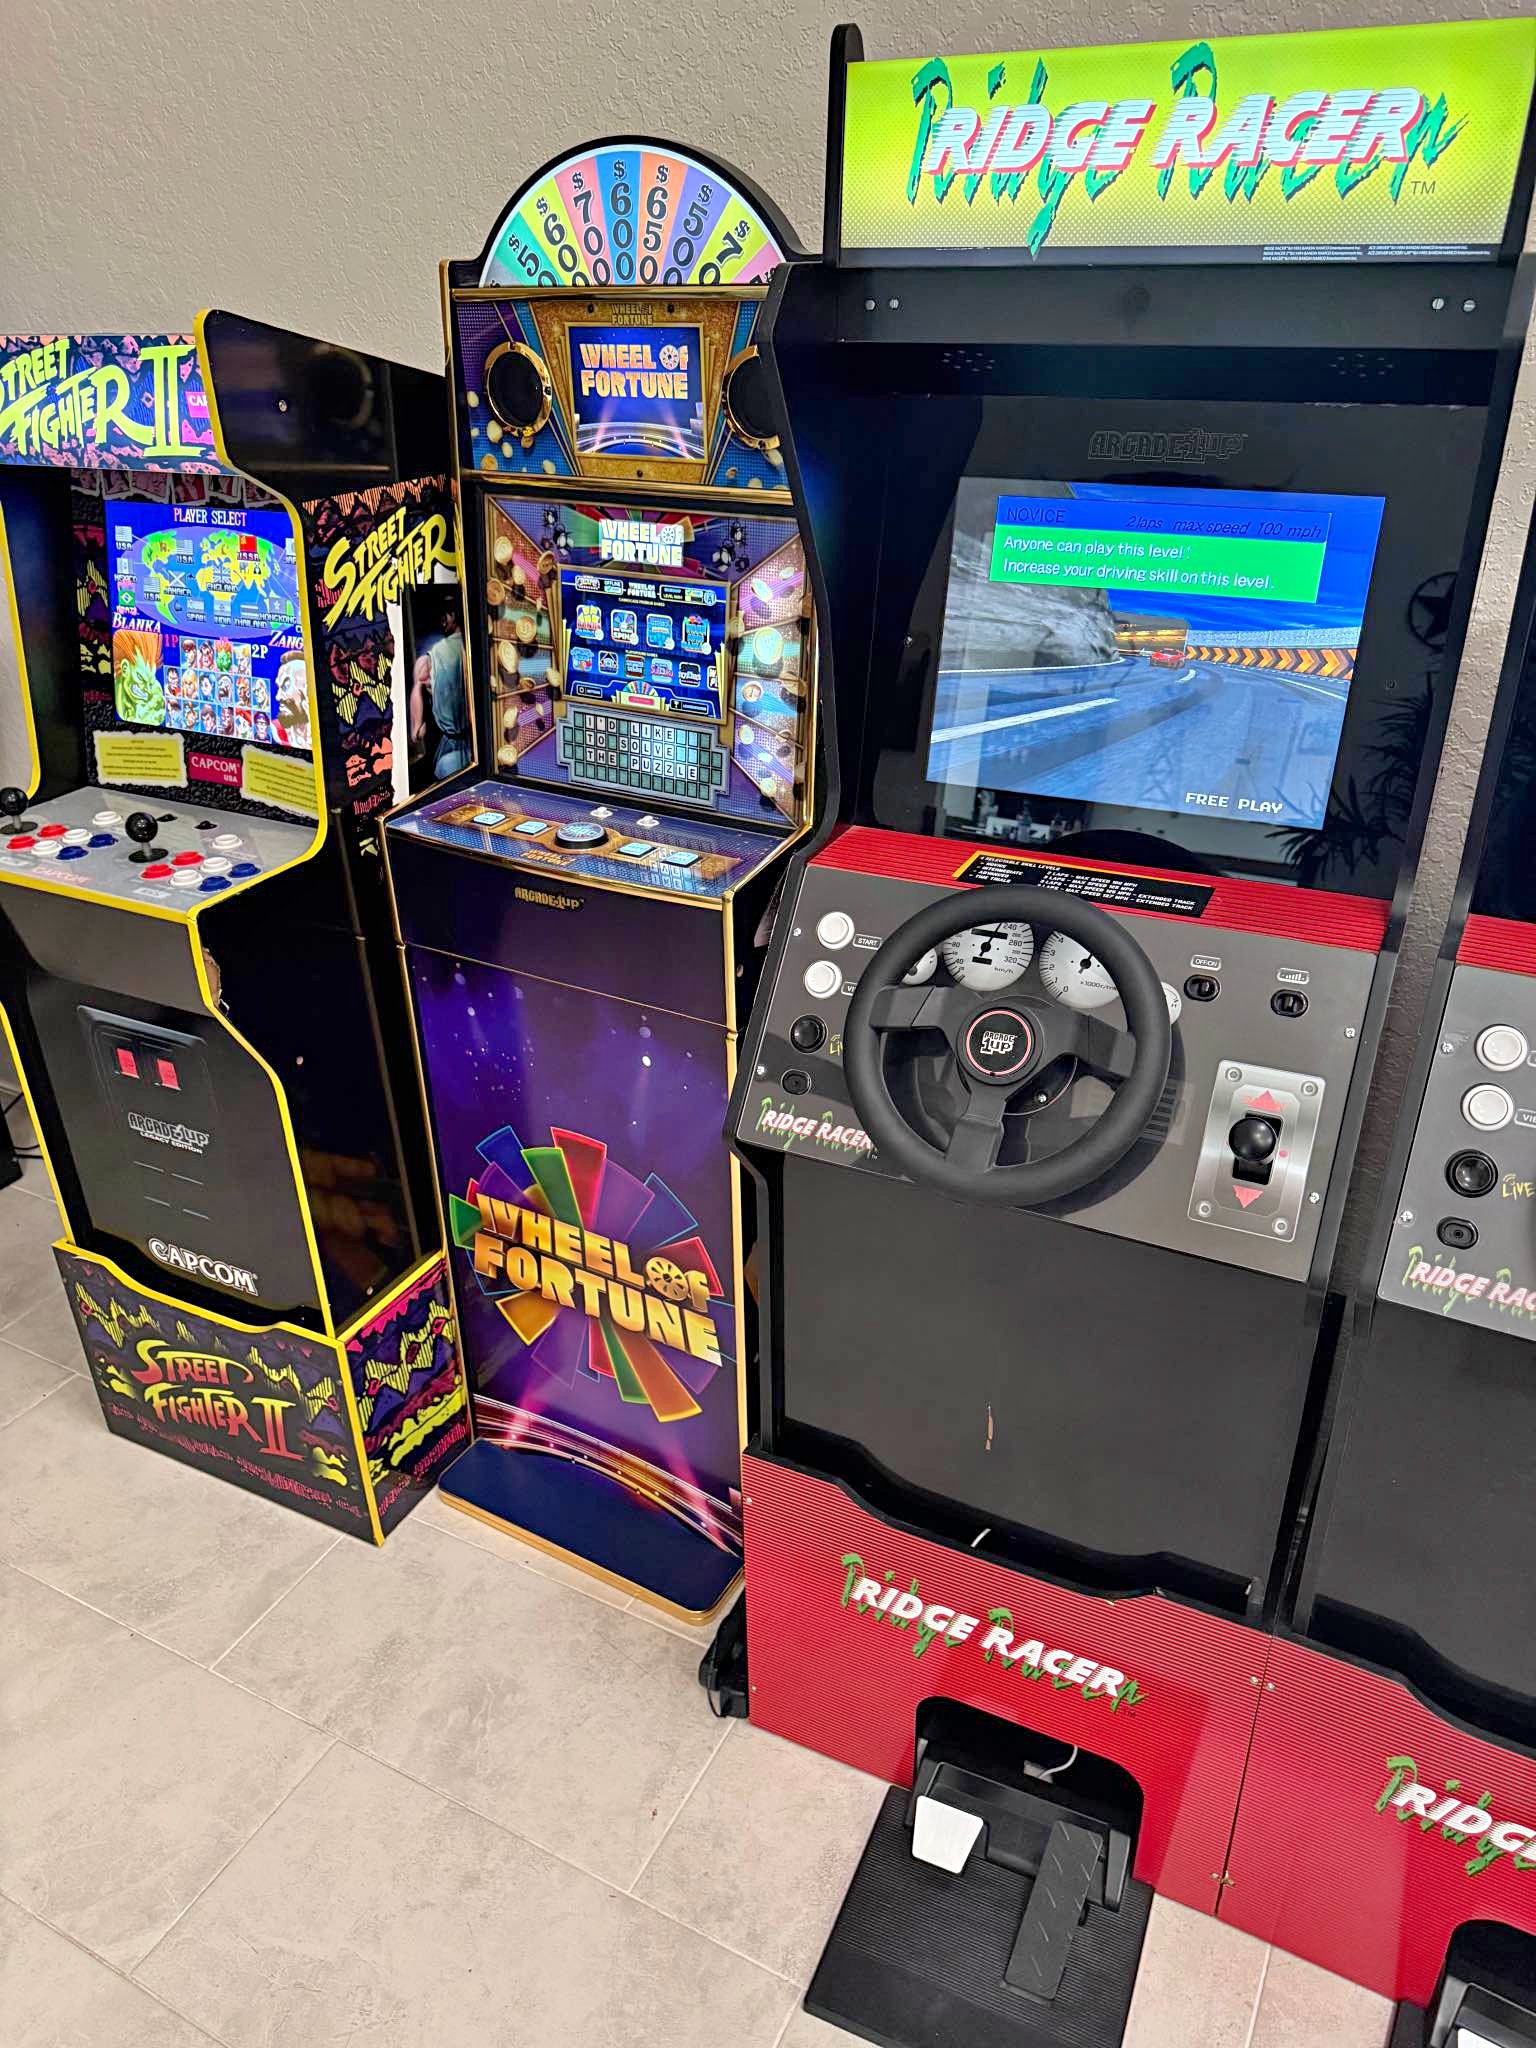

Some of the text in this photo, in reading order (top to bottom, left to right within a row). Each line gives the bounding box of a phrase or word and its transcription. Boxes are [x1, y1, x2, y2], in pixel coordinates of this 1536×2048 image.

[923, 100, 1156, 174] RIDGE
[1153, 88, 1427, 172] RACER
[610, 159, 634, 281] $600
[639, 164, 669, 284] $650
[579, 343, 657, 370] WHEEL
[0, 339, 70, 410] TREET
[580, 371, 689, 400] FORTUNE
[0, 364, 155, 456] FIGHTER
[173, 508, 247, 527] PLAYER SELECT
[1007, 507, 1066, 523] NOVICE
[600, 518, 659, 548] WHEEL
[1173, 520, 1203, 533] max
[1205, 520, 1251, 536] speed
[1257, 522, 1283, 537] 100
[1286, 525, 1322, 540] mph
[600, 540, 684, 567] FORTUNE
[1003, 535, 1054, 552] Anyone
[1056, 541, 1082, 553] can
[1085, 541, 1115, 557] play
[1117, 542, 1146, 557] this
[322, 506, 406, 632] STREET
[346, 514, 457, 621] FIGHTER
[1003, 559, 1061, 575] Increase
[1063, 565, 1094, 578] your
[1096, 564, 1147, 583] driving
[1149, 567, 1178, 583] skill
[1180, 572, 1199, 585] on
[1201, 571, 1230, 587] this
[113, 612, 161, 633] BLANKA
[252, 644, 268, 659] 2P
[587, 733, 605, 746] TO
[632, 723, 673, 740] LIKE
[586, 751, 616, 765] THE
[620, 738, 673, 756] SOLVE
[191, 756, 240, 774] CAPCOM
[631, 758, 697, 778] PUZZLE
[1185, 791, 1284, 815] FREE PLAY
[857, 938, 878, 946] START
[762, 1109, 818, 1137] RIDGE
[476, 1193, 646, 1289] WHEEL
[149, 1237, 259, 1297] CAPCOM
[1409, 1260, 1491, 1297] RIDGE
[474, 1231, 722, 1367] FORTUNE
[131, 1339, 254, 1385] STREET
[144, 1383, 264, 1443] FIGHTER
[850, 1577, 980, 1641] RIDGE
[979, 1625, 1125, 1698] RACER
